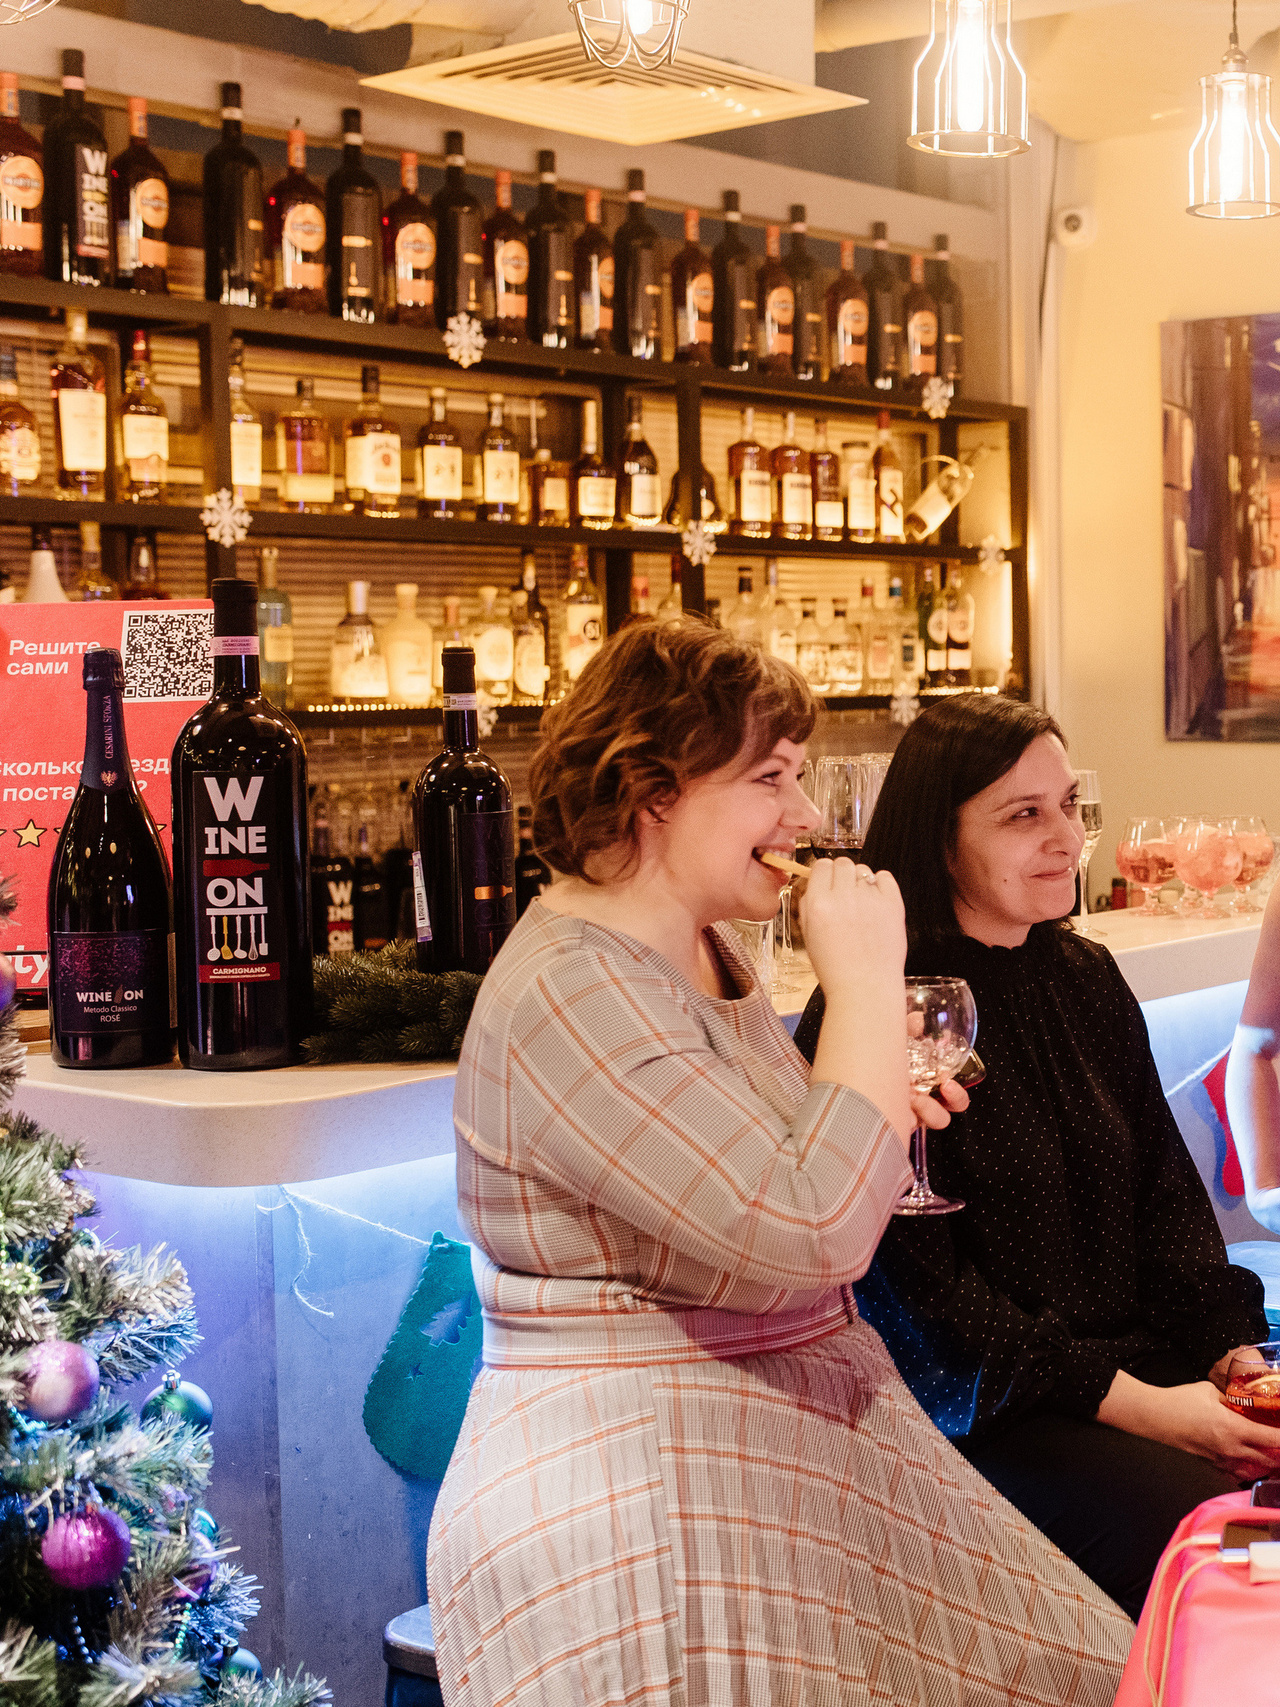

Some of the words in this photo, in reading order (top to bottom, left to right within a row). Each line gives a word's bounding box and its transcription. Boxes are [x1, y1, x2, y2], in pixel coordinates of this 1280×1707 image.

[6, 661, 69, 675] сами
[104, 725, 114, 759] CESARINI
[203, 776, 265, 822] W
[204, 825, 268, 855] INE
[206, 877, 264, 907] ON
[212, 966, 267, 975] CARMIGNANO
[76, 991, 113, 1002] WINE
[123, 989, 144, 1001] ON
[83, 1006, 110, 1014] Metodo
[110, 1004, 138, 1013] Classico
[100, 1013, 121, 1023] ROSÉ
